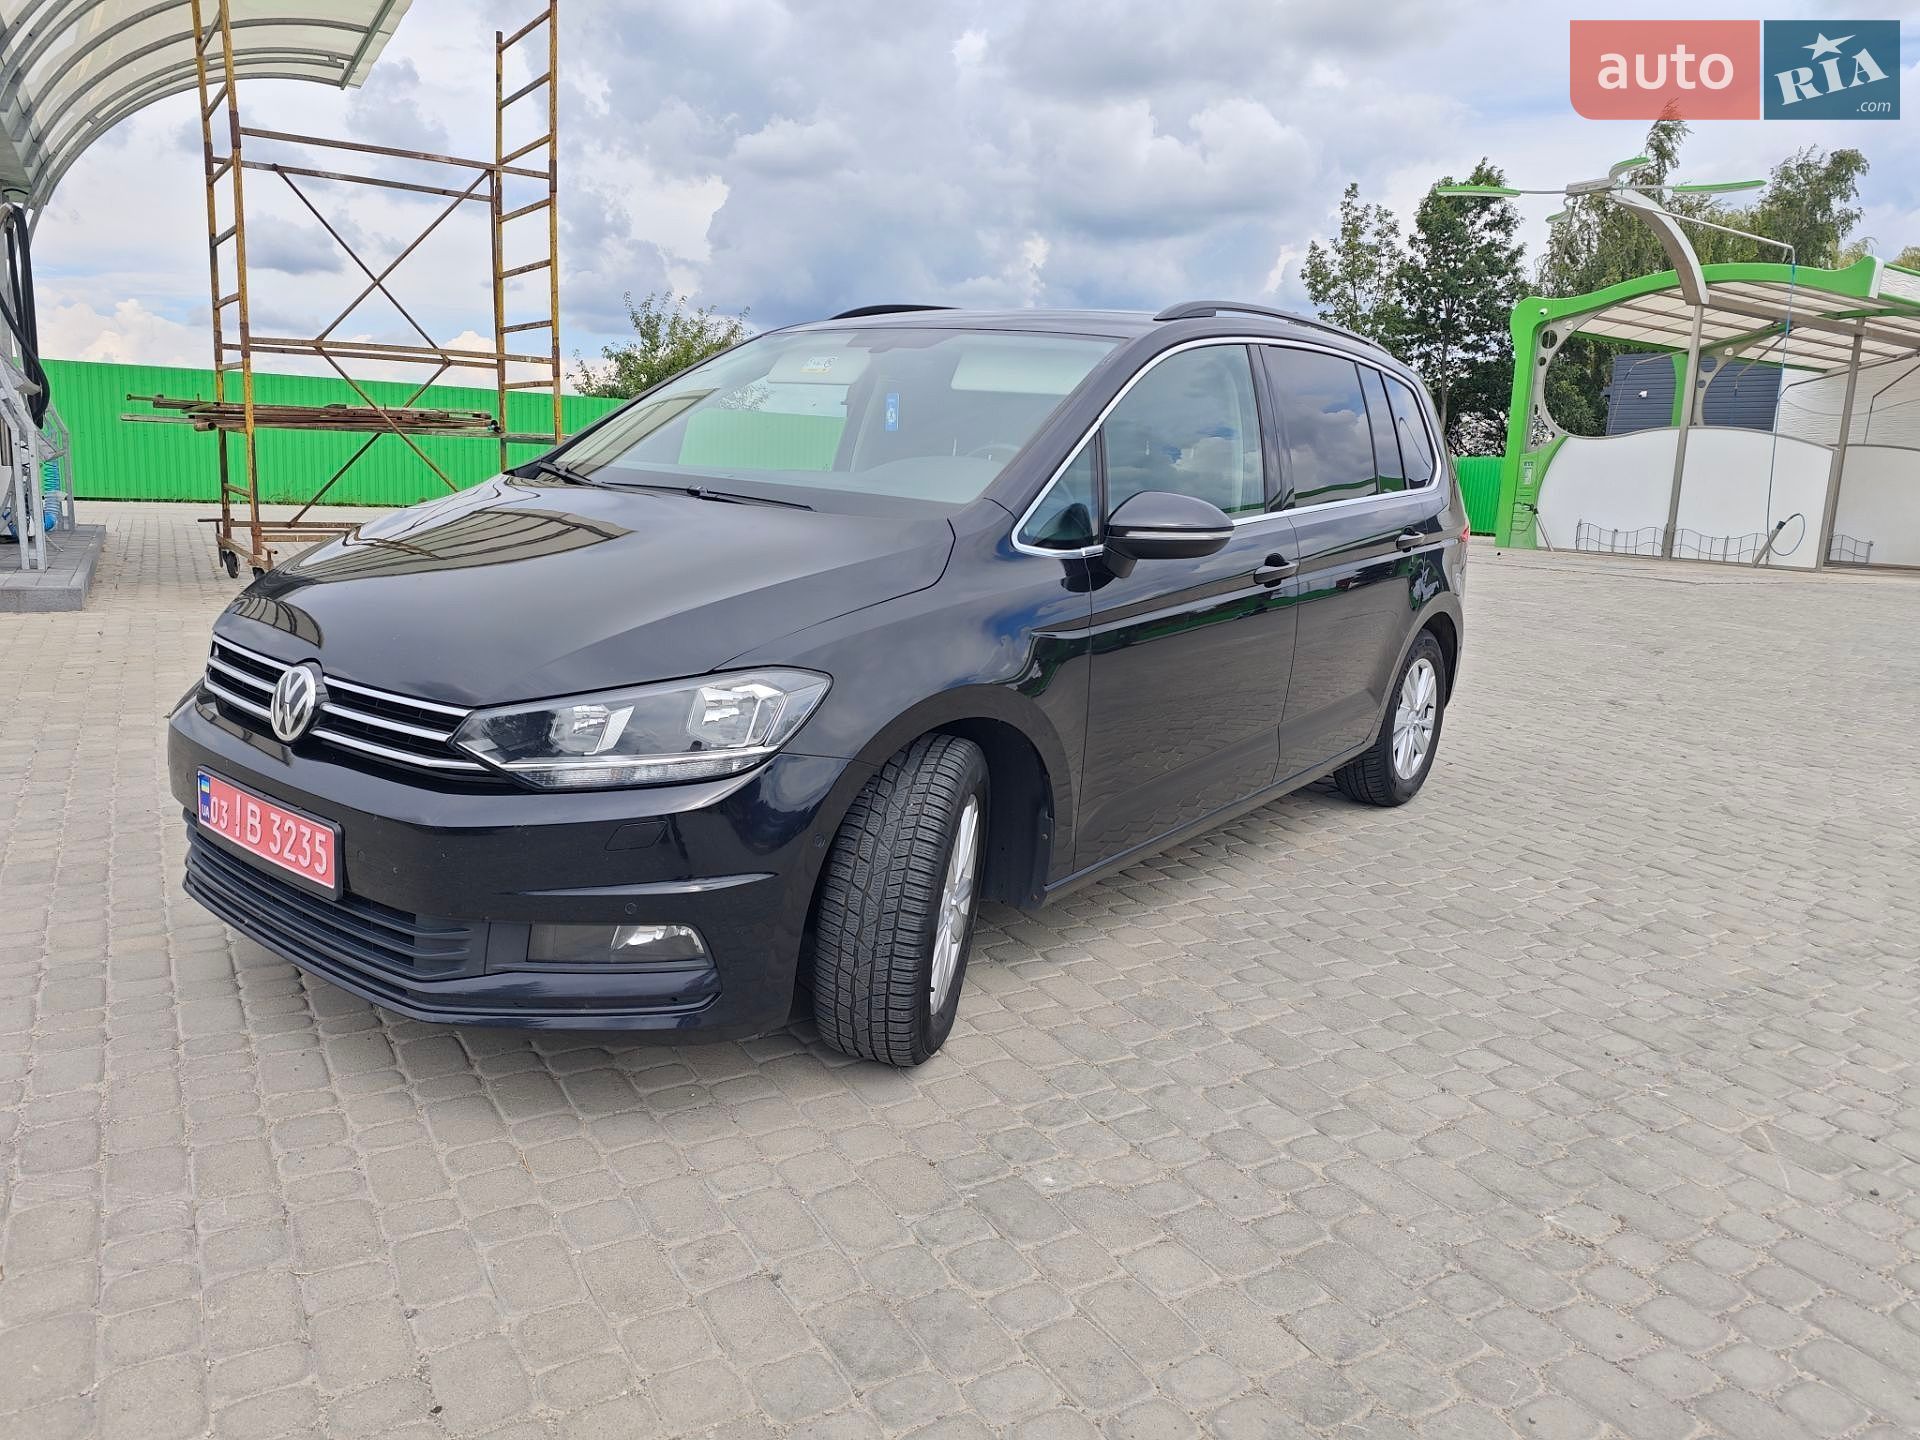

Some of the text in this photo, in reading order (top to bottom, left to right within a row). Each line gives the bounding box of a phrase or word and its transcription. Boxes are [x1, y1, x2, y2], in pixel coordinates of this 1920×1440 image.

[201, 803, 210, 819] UA
[210, 796, 229, 830] 03
[269, 812, 327, 875] 3235
